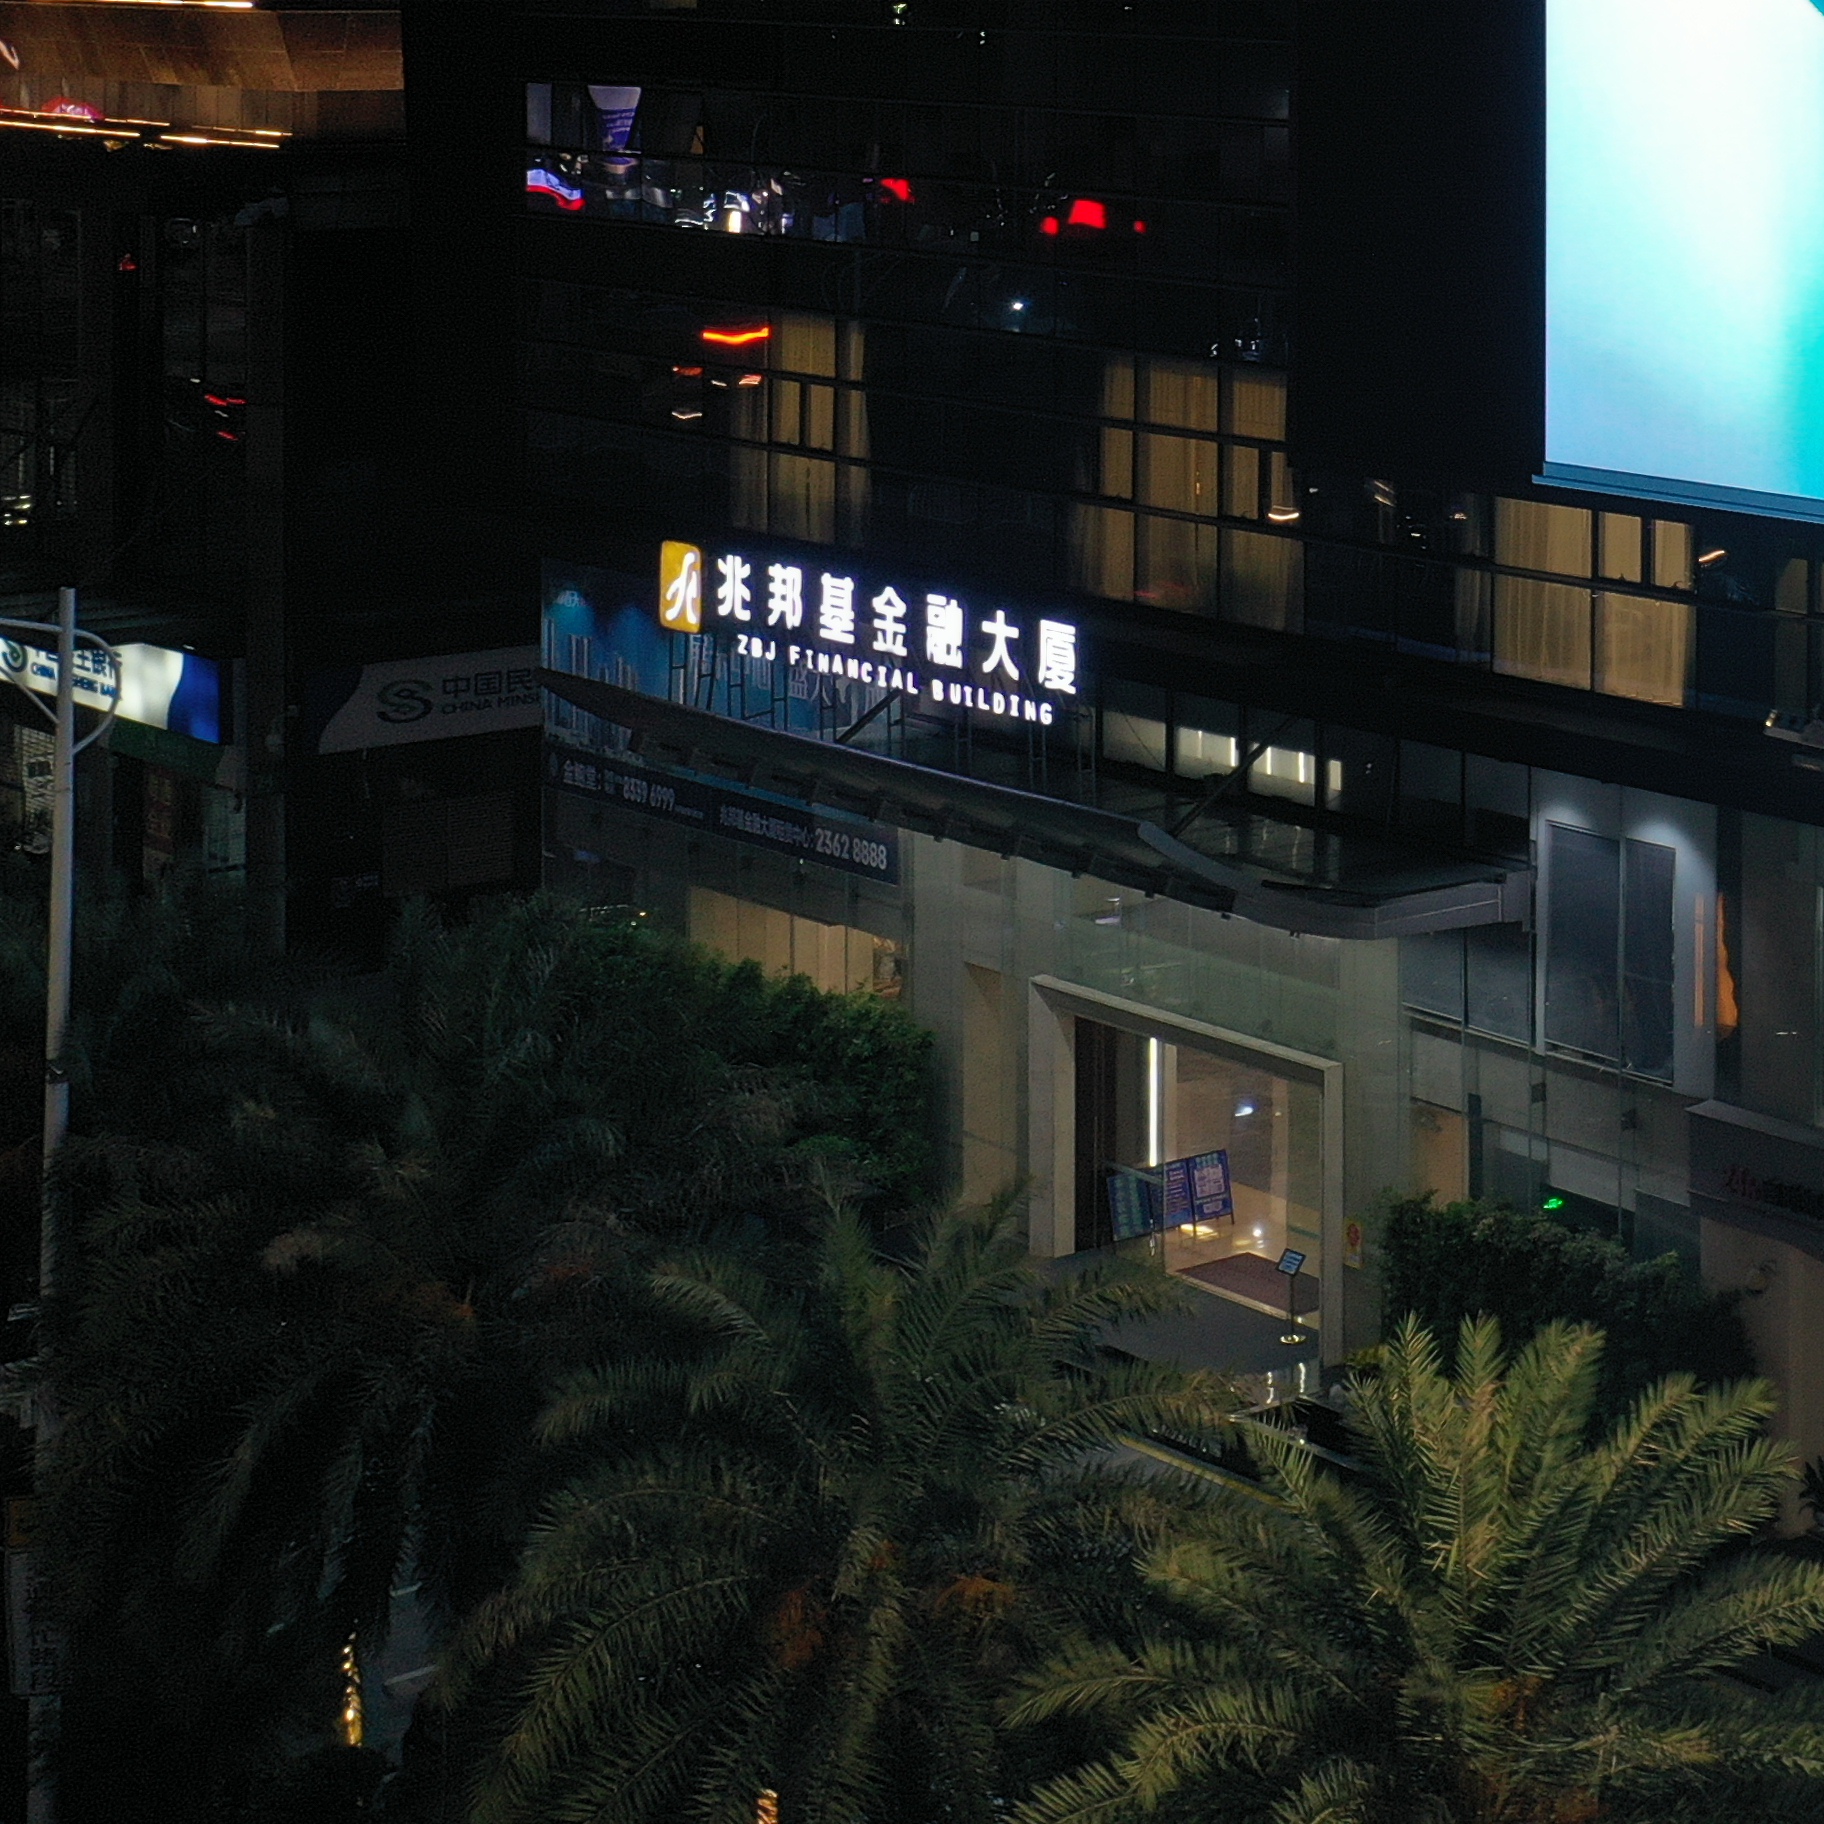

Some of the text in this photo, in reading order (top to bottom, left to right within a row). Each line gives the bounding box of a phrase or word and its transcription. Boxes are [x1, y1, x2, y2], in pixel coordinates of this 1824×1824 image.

[718, 555, 1077, 694] 兆邦基金融大厦
[442, 699, 492, 715] CHINA
[738, 634, 777, 662] ZBJ
[789, 644, 919, 696] FINANCIAL
[932, 679, 1053, 726] BUILDING
[814, 827, 850, 860] 2362
[852, 838, 888, 871] 8888
